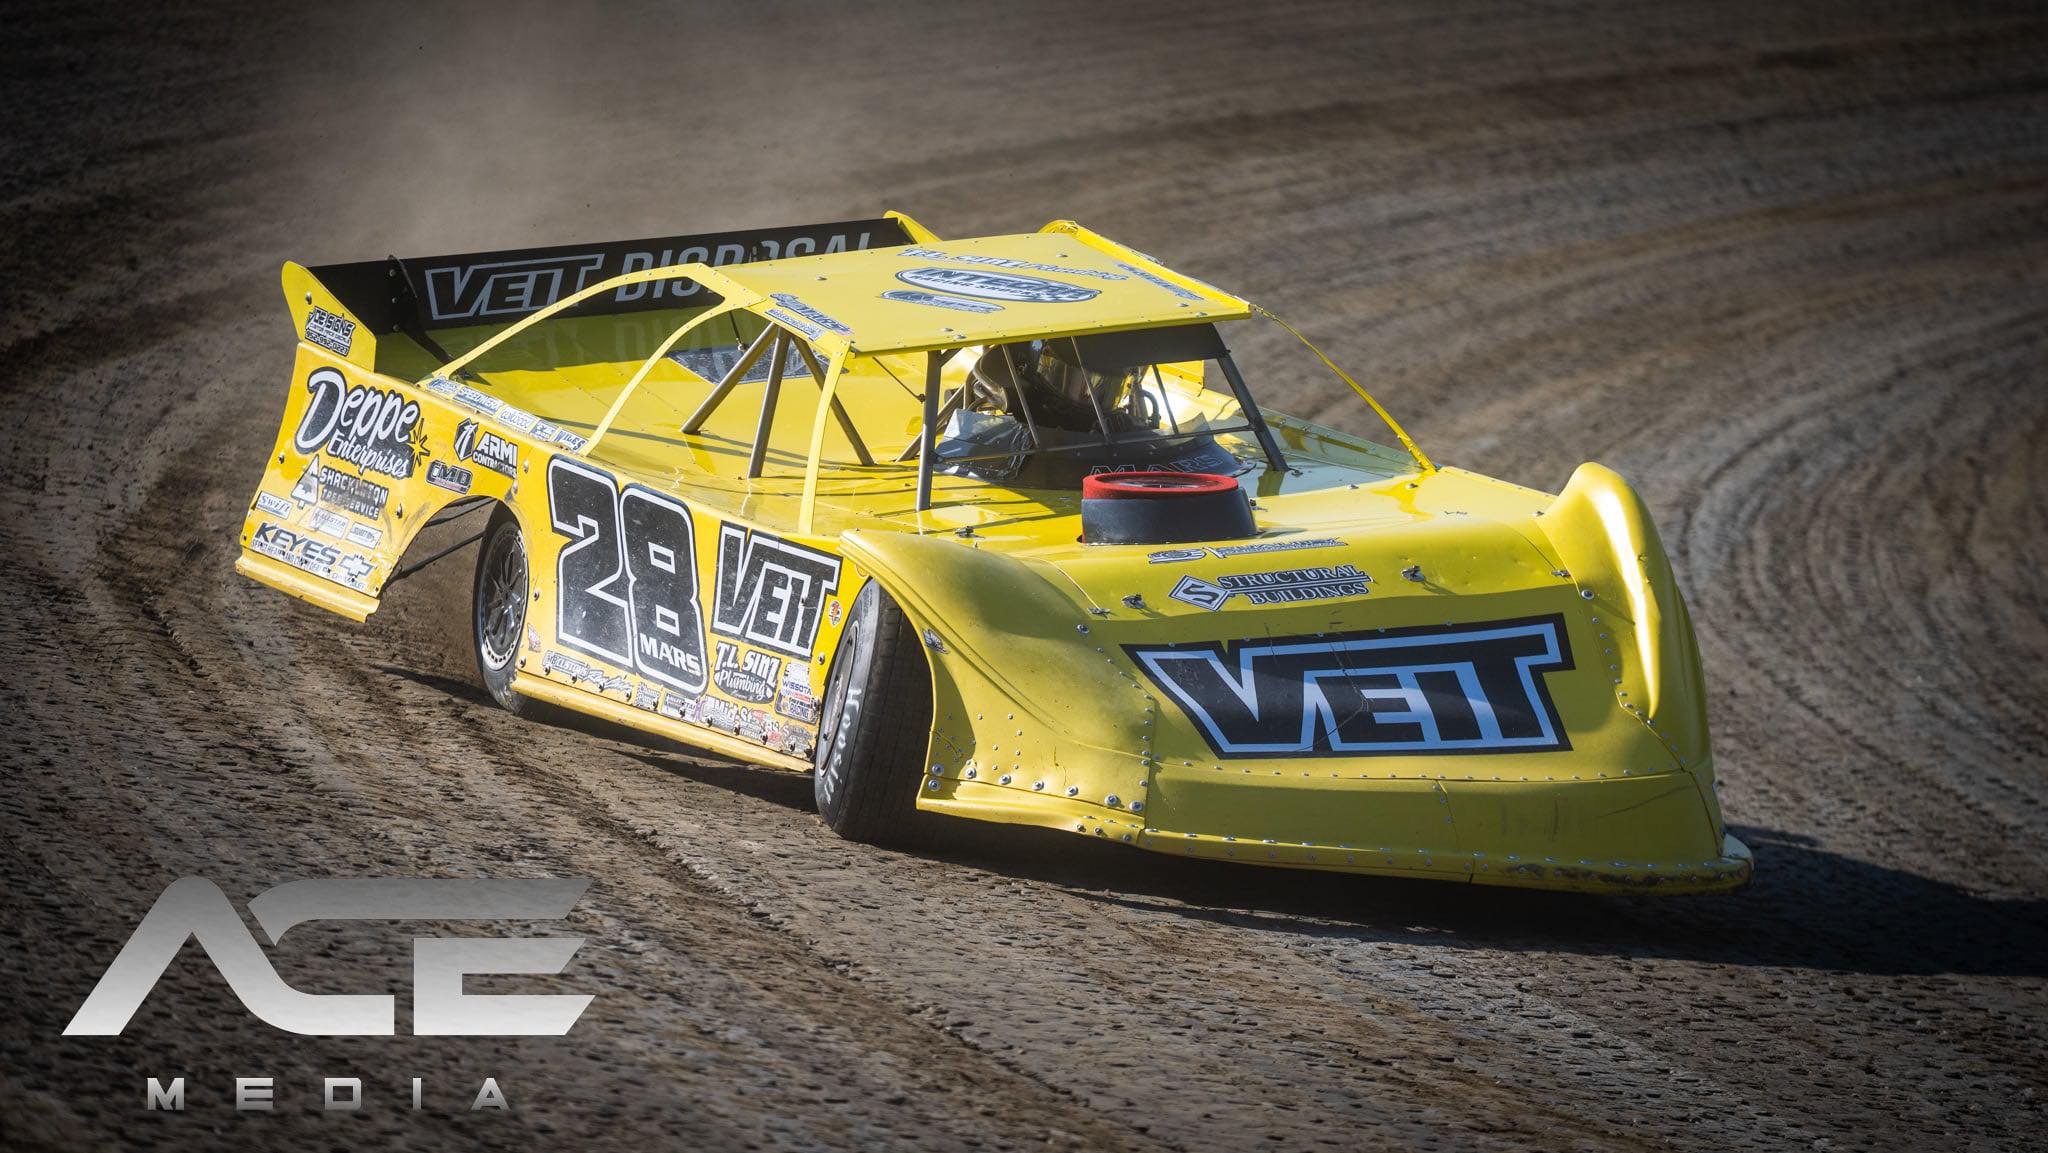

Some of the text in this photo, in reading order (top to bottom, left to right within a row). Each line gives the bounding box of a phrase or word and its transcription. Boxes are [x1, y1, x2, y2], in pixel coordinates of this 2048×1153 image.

[425, 232, 871, 321] VEIT DISP
[296, 370, 419, 449] Deppe
[327, 428, 410, 478] Enterprises
[477, 433, 518, 465] ARMI
[255, 522, 341, 566] KEYES
[549, 455, 707, 699] 28
[711, 523, 842, 660] VEIT
[1217, 565, 1364, 589] STRUCTURAL
[1250, 583, 1369, 604] BUILDINGS
[639, 633, 701, 676] MARS
[715, 641, 740, 671] T.L.
[718, 670, 766, 700] Plumbing
[782, 678, 812, 694] WISSOTA
[1133, 621, 1564, 753] VEIT
